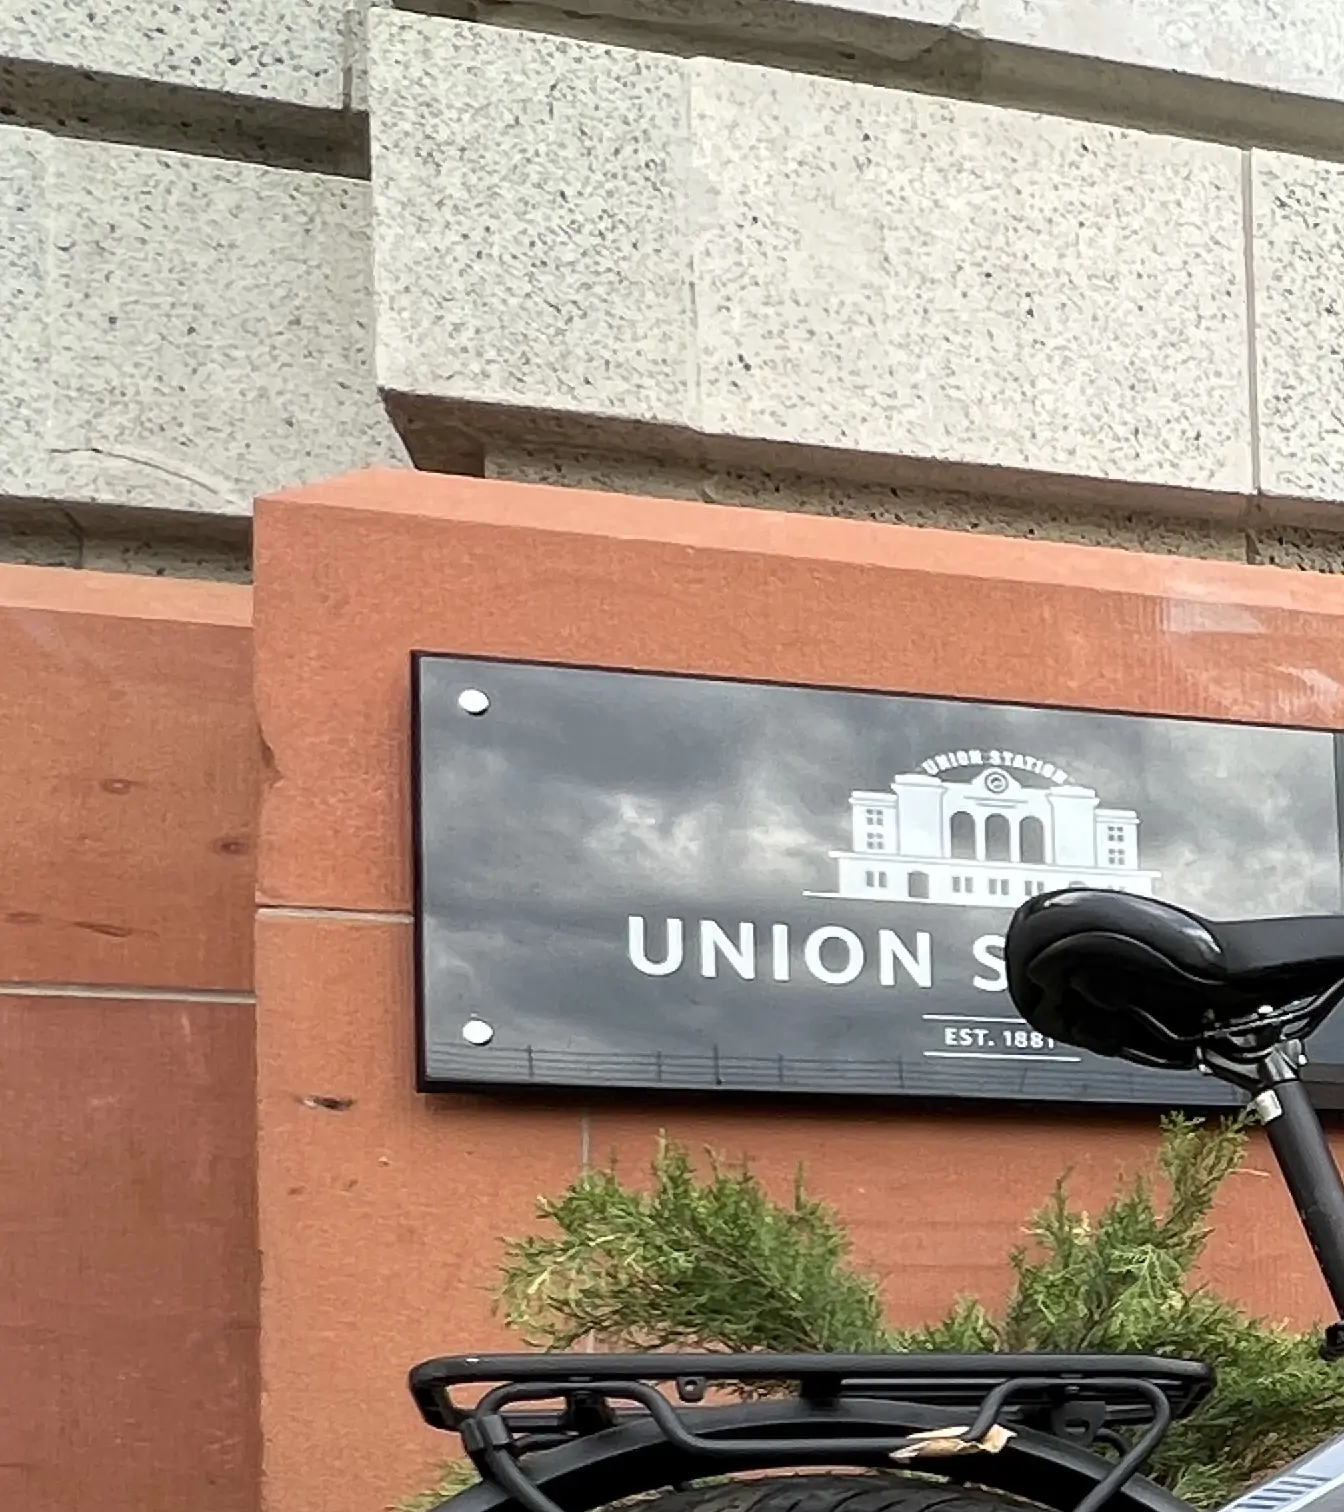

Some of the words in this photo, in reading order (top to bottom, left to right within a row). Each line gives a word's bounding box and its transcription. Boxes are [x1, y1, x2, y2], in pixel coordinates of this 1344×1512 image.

[922, 749, 983, 776] UNION
[989, 750, 1068, 784] STATION
[627, 915, 933, 989] UNION
[945, 1028, 995, 1046] EST.
